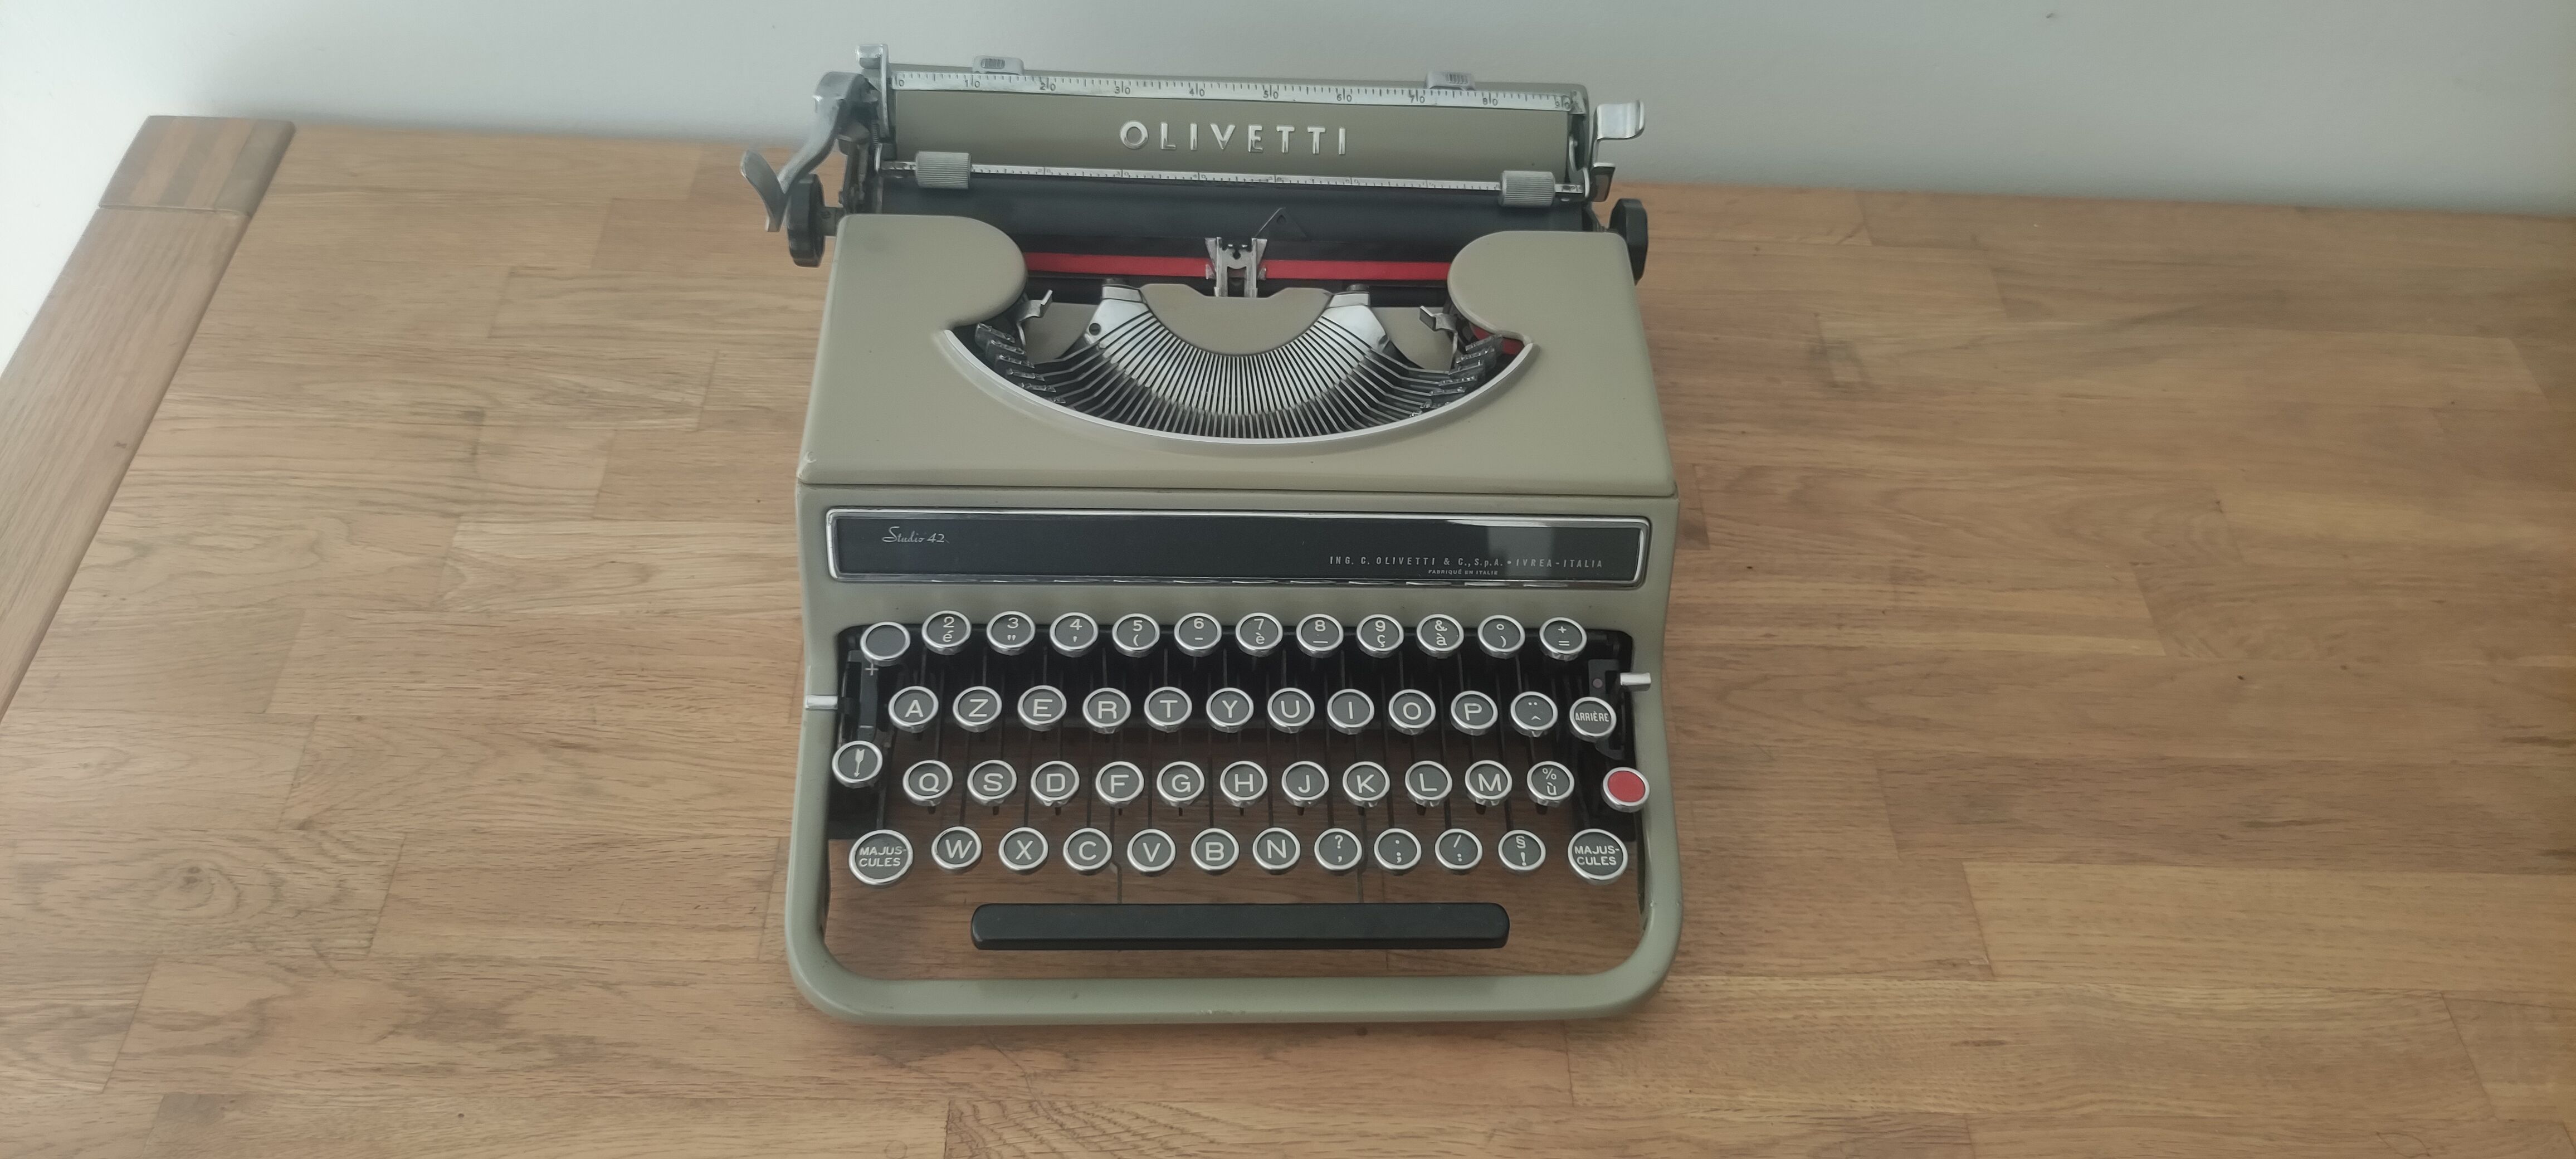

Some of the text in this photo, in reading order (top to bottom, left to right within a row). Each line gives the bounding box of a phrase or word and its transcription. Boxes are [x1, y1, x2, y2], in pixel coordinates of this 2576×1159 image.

[1119, 120, 1346, 155] OLIVETTI
[882, 526, 945, 543] Studio 42
[1330, 556, 1354, 565] ING.
[1360, 557, 1370, 565] C.
[1376, 557, 1435, 566] OLIVETTI
[1443, 557, 1450, 566] &
[943, 616, 955, 629] 2
[1007, 617, 1019, 629] 3
[1069, 618, 1083, 631] 4
[1132, 619, 1144, 632] 5
[1193, 617, 1205, 630] 6
[1253, 618, 1265, 630] 7
[1314, 620, 1326, 632] 8
[1374, 620, 1387, 633] 9
[941, 630, 953, 643] é
[1255, 632, 1265, 645] è
[1377, 635, 1385, 647] ç
[1436, 632, 1447, 646] à
[904, 699, 924, 718] A
[968, 699, 988, 717] Z
[1032, 699, 1053, 718] E
[1097, 700, 1118, 719] R
[1159, 699, 1178, 718] T
[1222, 700, 1238, 718] Y
[1281, 700, 1300, 718] U
[1402, 702, 1422, 720] O
[1463, 702, 1483, 722] P
[1574, 710, 1610, 723] ARRIÈRE
[918, 772, 940, 793] Q
[983, 773, 1003, 792] S
[1046, 773, 1066, 792] D
[1110, 774, 1129, 793] F
[1172, 774, 1191, 793] G
[1235, 773, 1254, 792] H
[1298, 775, 1311, 793] J
[1357, 774, 1376, 793] K
[1419, 773, 1437, 792] L
[1477, 773, 1502, 792] M
[1546, 782, 1558, 797] ù
[858, 845, 909, 857] MAJUS-
[945, 839, 973, 860] W
[1016, 840, 1033, 860] X
[1079, 841, 1097, 861] C
[1143, 843, 1161, 863] V
[1204, 841, 1225, 862] B
[1267, 839, 1287, 859] N
[1574, 845, 1620, 856] MAJUS-
[858, 856, 902, 868] CULES
[1576, 855, 1617, 867] CULES
